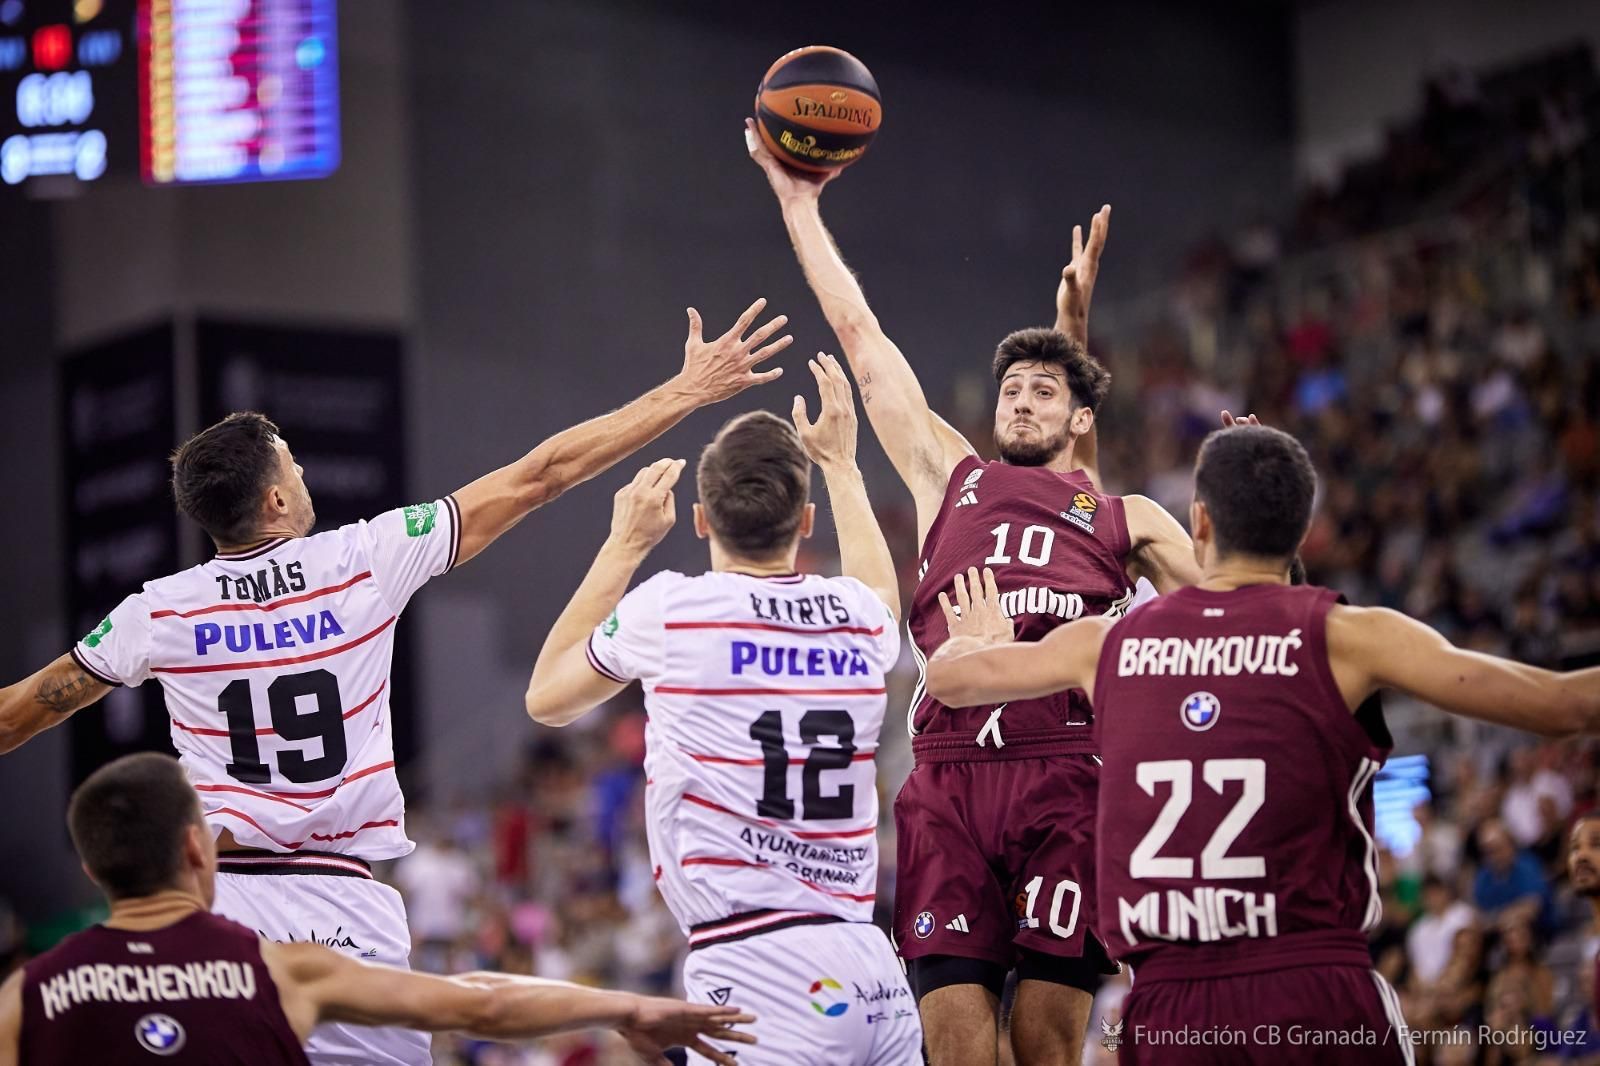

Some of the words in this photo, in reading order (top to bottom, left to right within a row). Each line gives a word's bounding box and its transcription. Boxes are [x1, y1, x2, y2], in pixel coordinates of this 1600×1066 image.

[793, 97, 873, 128] SPALDING
[985, 523, 1055, 567] 10
[216, 559, 306, 602] TOMÀS
[195, 610, 345, 655] PULEVA
[1118, 628, 1302, 677] BRANKOVIĆ
[731, 642, 869, 676] PULEVA
[218, 668, 348, 784] 19
[750, 710, 858, 821] 12
[1129, 758, 1266, 880] 22
[1025, 876, 1082, 938] 10
[1118, 887, 1278, 946] MUNICH
[259, 926, 360, 950] lucía
[39, 960, 256, 1020] KHARCHENKOV
